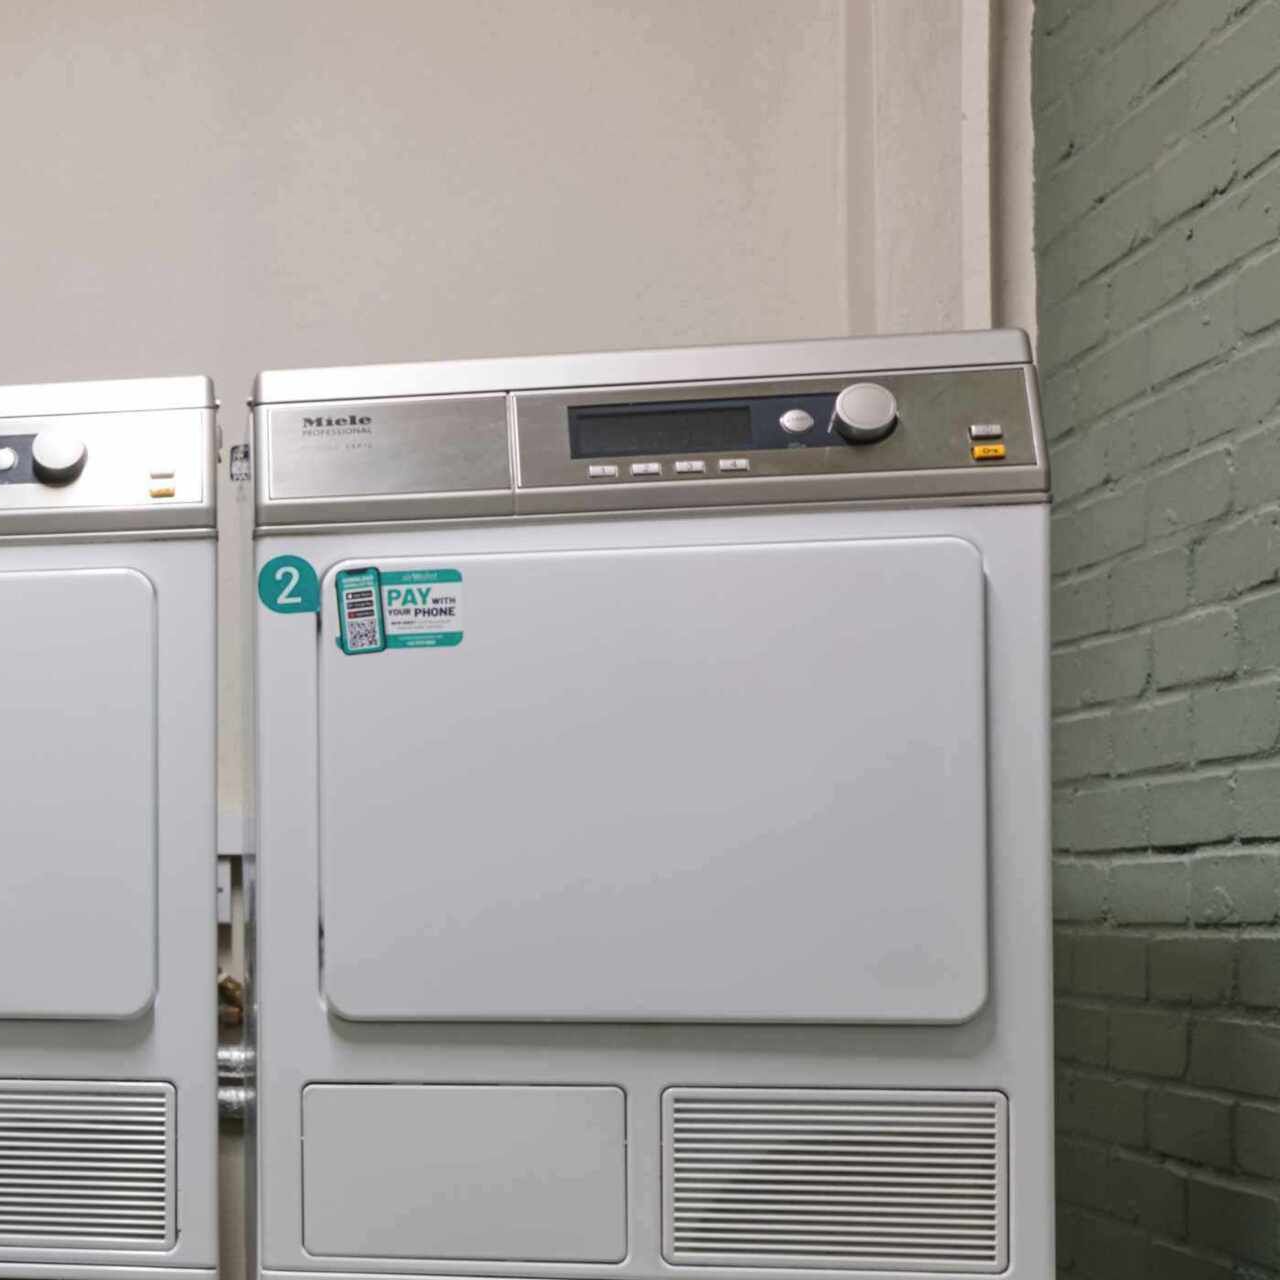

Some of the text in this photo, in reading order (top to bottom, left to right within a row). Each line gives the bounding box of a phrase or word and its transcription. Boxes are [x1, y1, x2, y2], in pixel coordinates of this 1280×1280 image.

[303, 415, 372, 428] Miele
[302, 428, 373, 437] PROFESSIONAL
[275, 566, 302, 604] 2
[386, 587, 432, 607] PAY
[431, 596, 456, 605] WITH
[388, 606, 455, 618] YOUR PHONE
